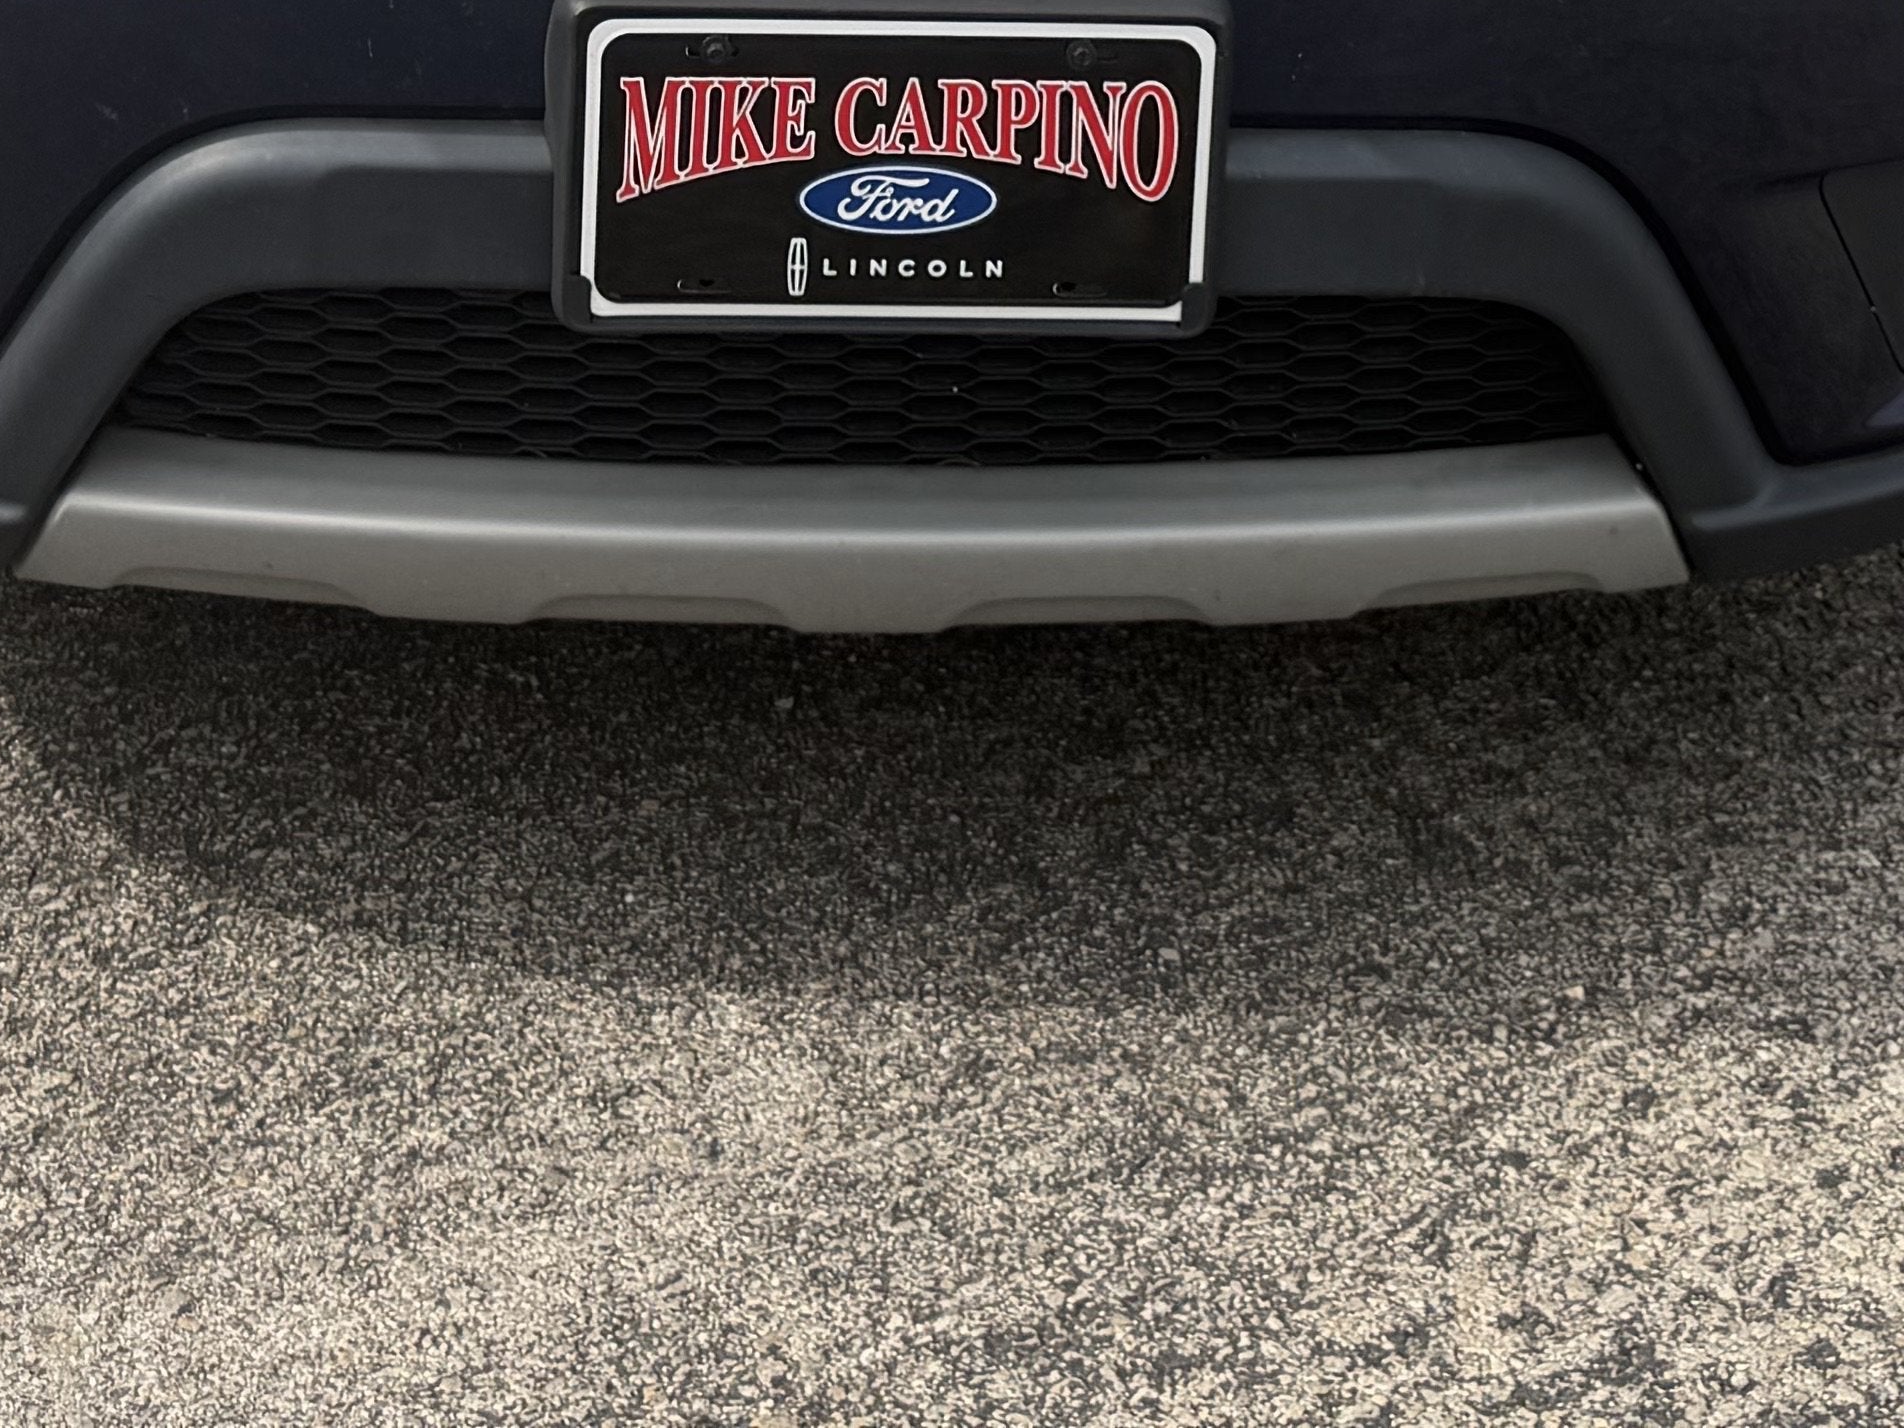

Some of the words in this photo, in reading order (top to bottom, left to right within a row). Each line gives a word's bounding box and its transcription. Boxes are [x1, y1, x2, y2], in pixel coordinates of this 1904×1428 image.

[616, 76, 816, 202] MIKE
[834, 76, 1179, 202] CARPINO
[836, 173, 956, 225] Ford
[823, 258, 1004, 279] LINCOLN
